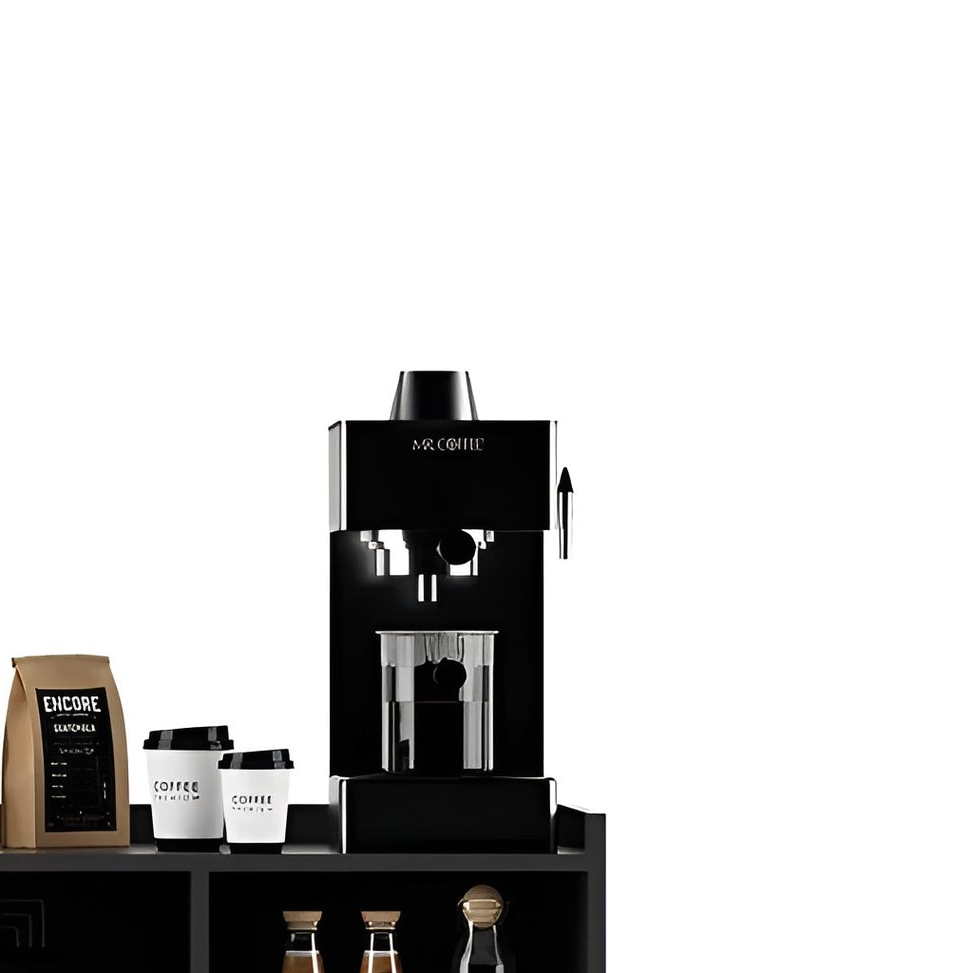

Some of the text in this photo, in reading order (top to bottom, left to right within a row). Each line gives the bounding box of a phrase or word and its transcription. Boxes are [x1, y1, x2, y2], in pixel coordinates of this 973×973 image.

[43, 695, 102, 713] ENCORE
[154, 780, 199, 793] COFFEE
[231, 795, 272, 805] COFFEE
